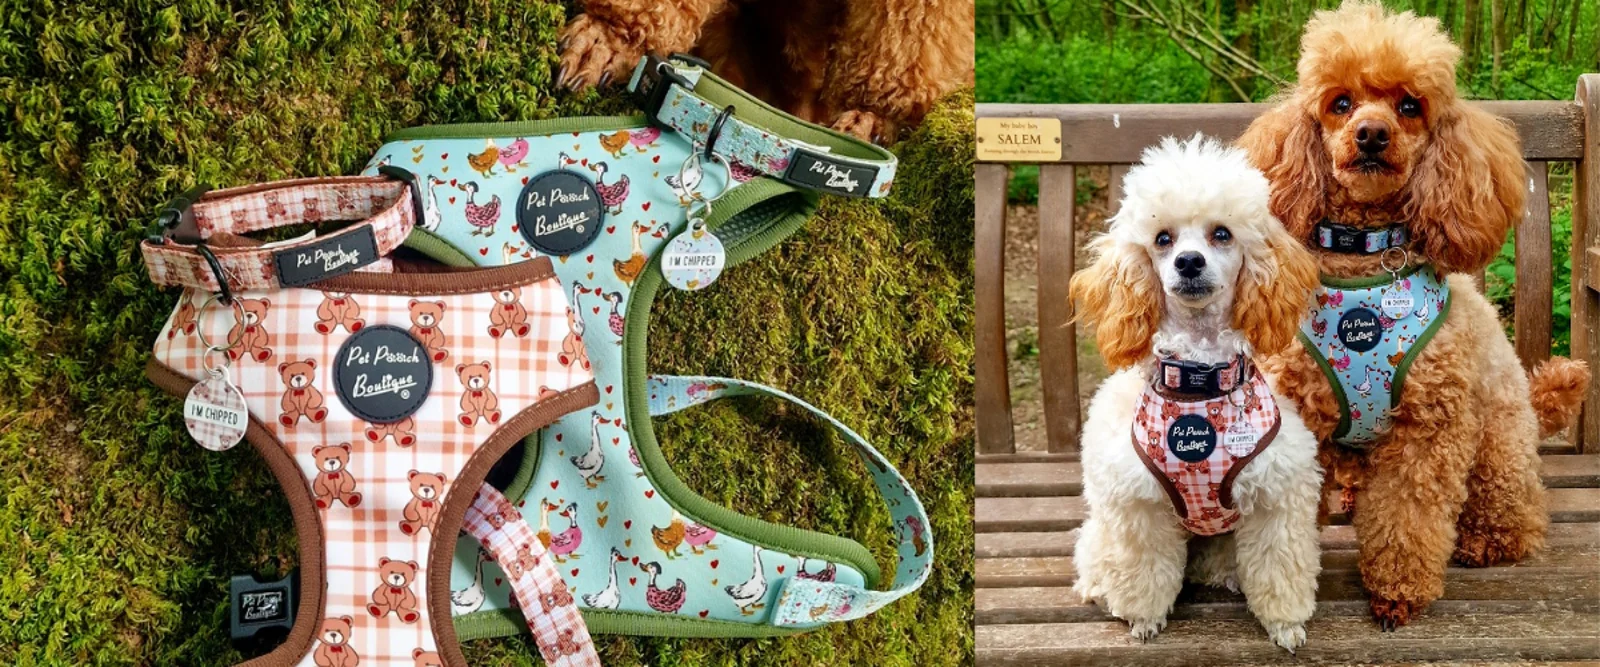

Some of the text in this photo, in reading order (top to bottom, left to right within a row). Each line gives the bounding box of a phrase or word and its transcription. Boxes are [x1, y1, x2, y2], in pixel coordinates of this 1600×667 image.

[997, 134, 1042, 145] SALEM
[526, 191, 546, 210] Pet
[535, 211, 589, 237] Boutique
[296, 253, 312, 268] Pet
[683, 255, 717, 266] CHIPPED
[346, 346, 370, 367] Pet
[353, 373, 416, 398] Boutique
[205, 407, 238, 425] CHIPPED
